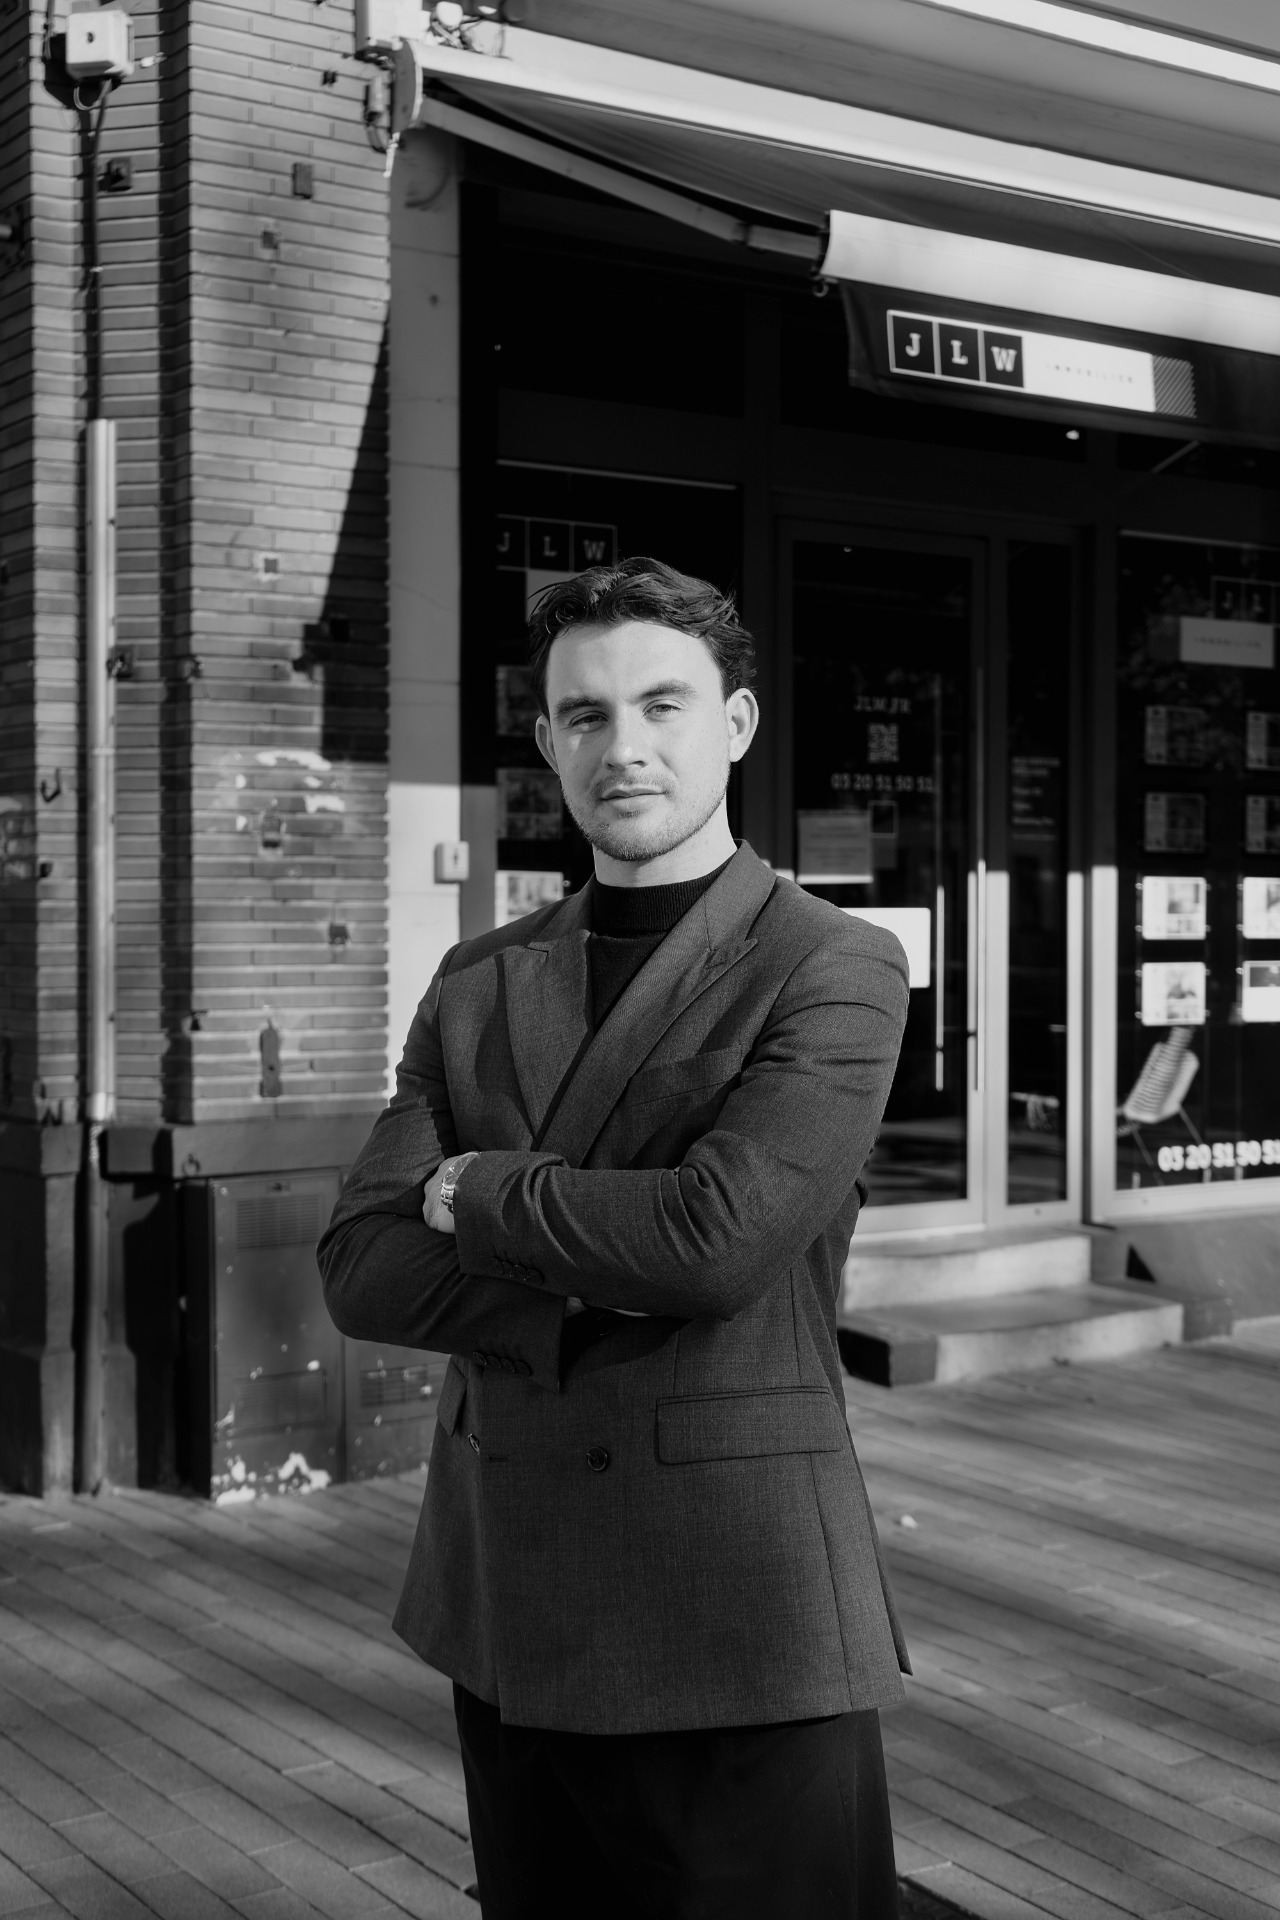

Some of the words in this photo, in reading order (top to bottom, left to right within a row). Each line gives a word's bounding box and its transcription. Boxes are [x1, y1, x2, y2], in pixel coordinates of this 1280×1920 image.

[1185, 1144, 1212, 1170] 20
[1212, 1142, 1236, 1169] 51
[1236, 1140, 1262, 1167] 50
